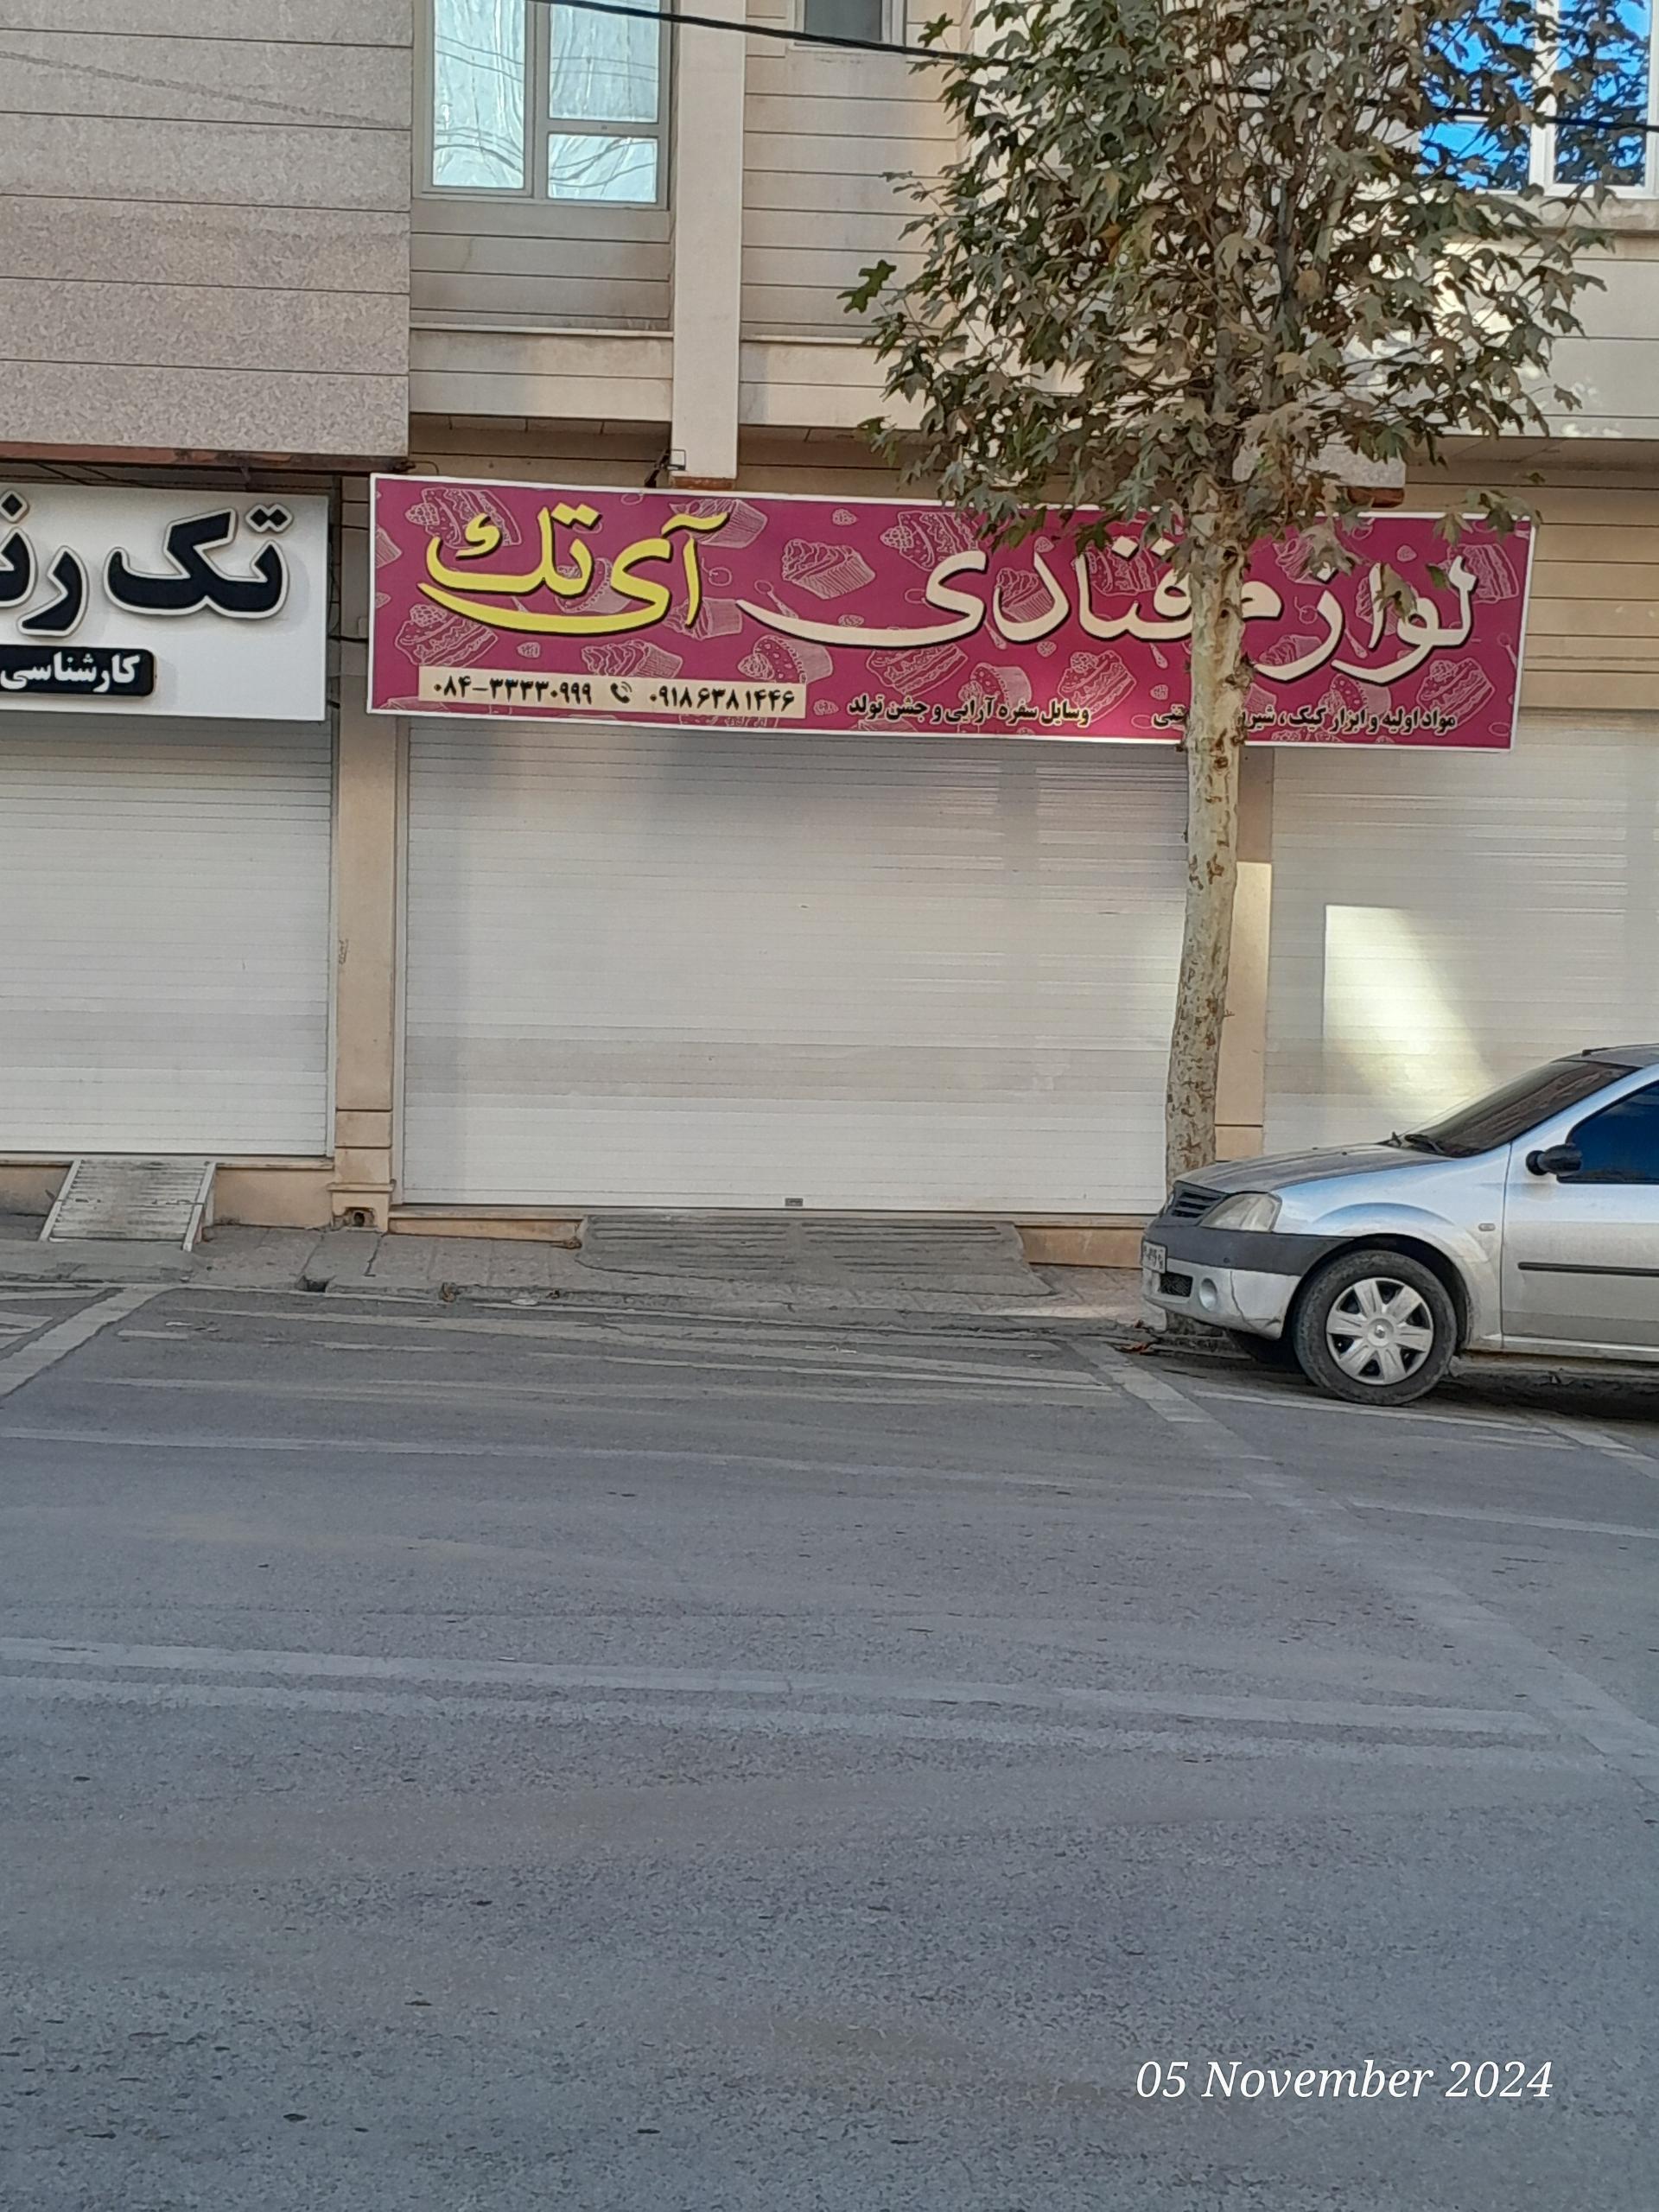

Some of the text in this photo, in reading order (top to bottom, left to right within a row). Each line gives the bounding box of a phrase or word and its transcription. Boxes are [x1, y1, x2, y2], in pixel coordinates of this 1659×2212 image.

[0, 490, 291, 637] تک رن
[0, 651, 141, 692] کارشناسی
[649, 684, 796, 712] ۰۹۱۸۶۳۸۱۴۴۶
[849, 694, 1090, 726] وسایل سفره آرایی و جشن تولد
[1328, 708, 1366, 733] ابزار
[1369, 714, 1379, 733] و
[1383, 708, 1419, 734] اولیه
[1421, 709, 1457, 734] مواد
